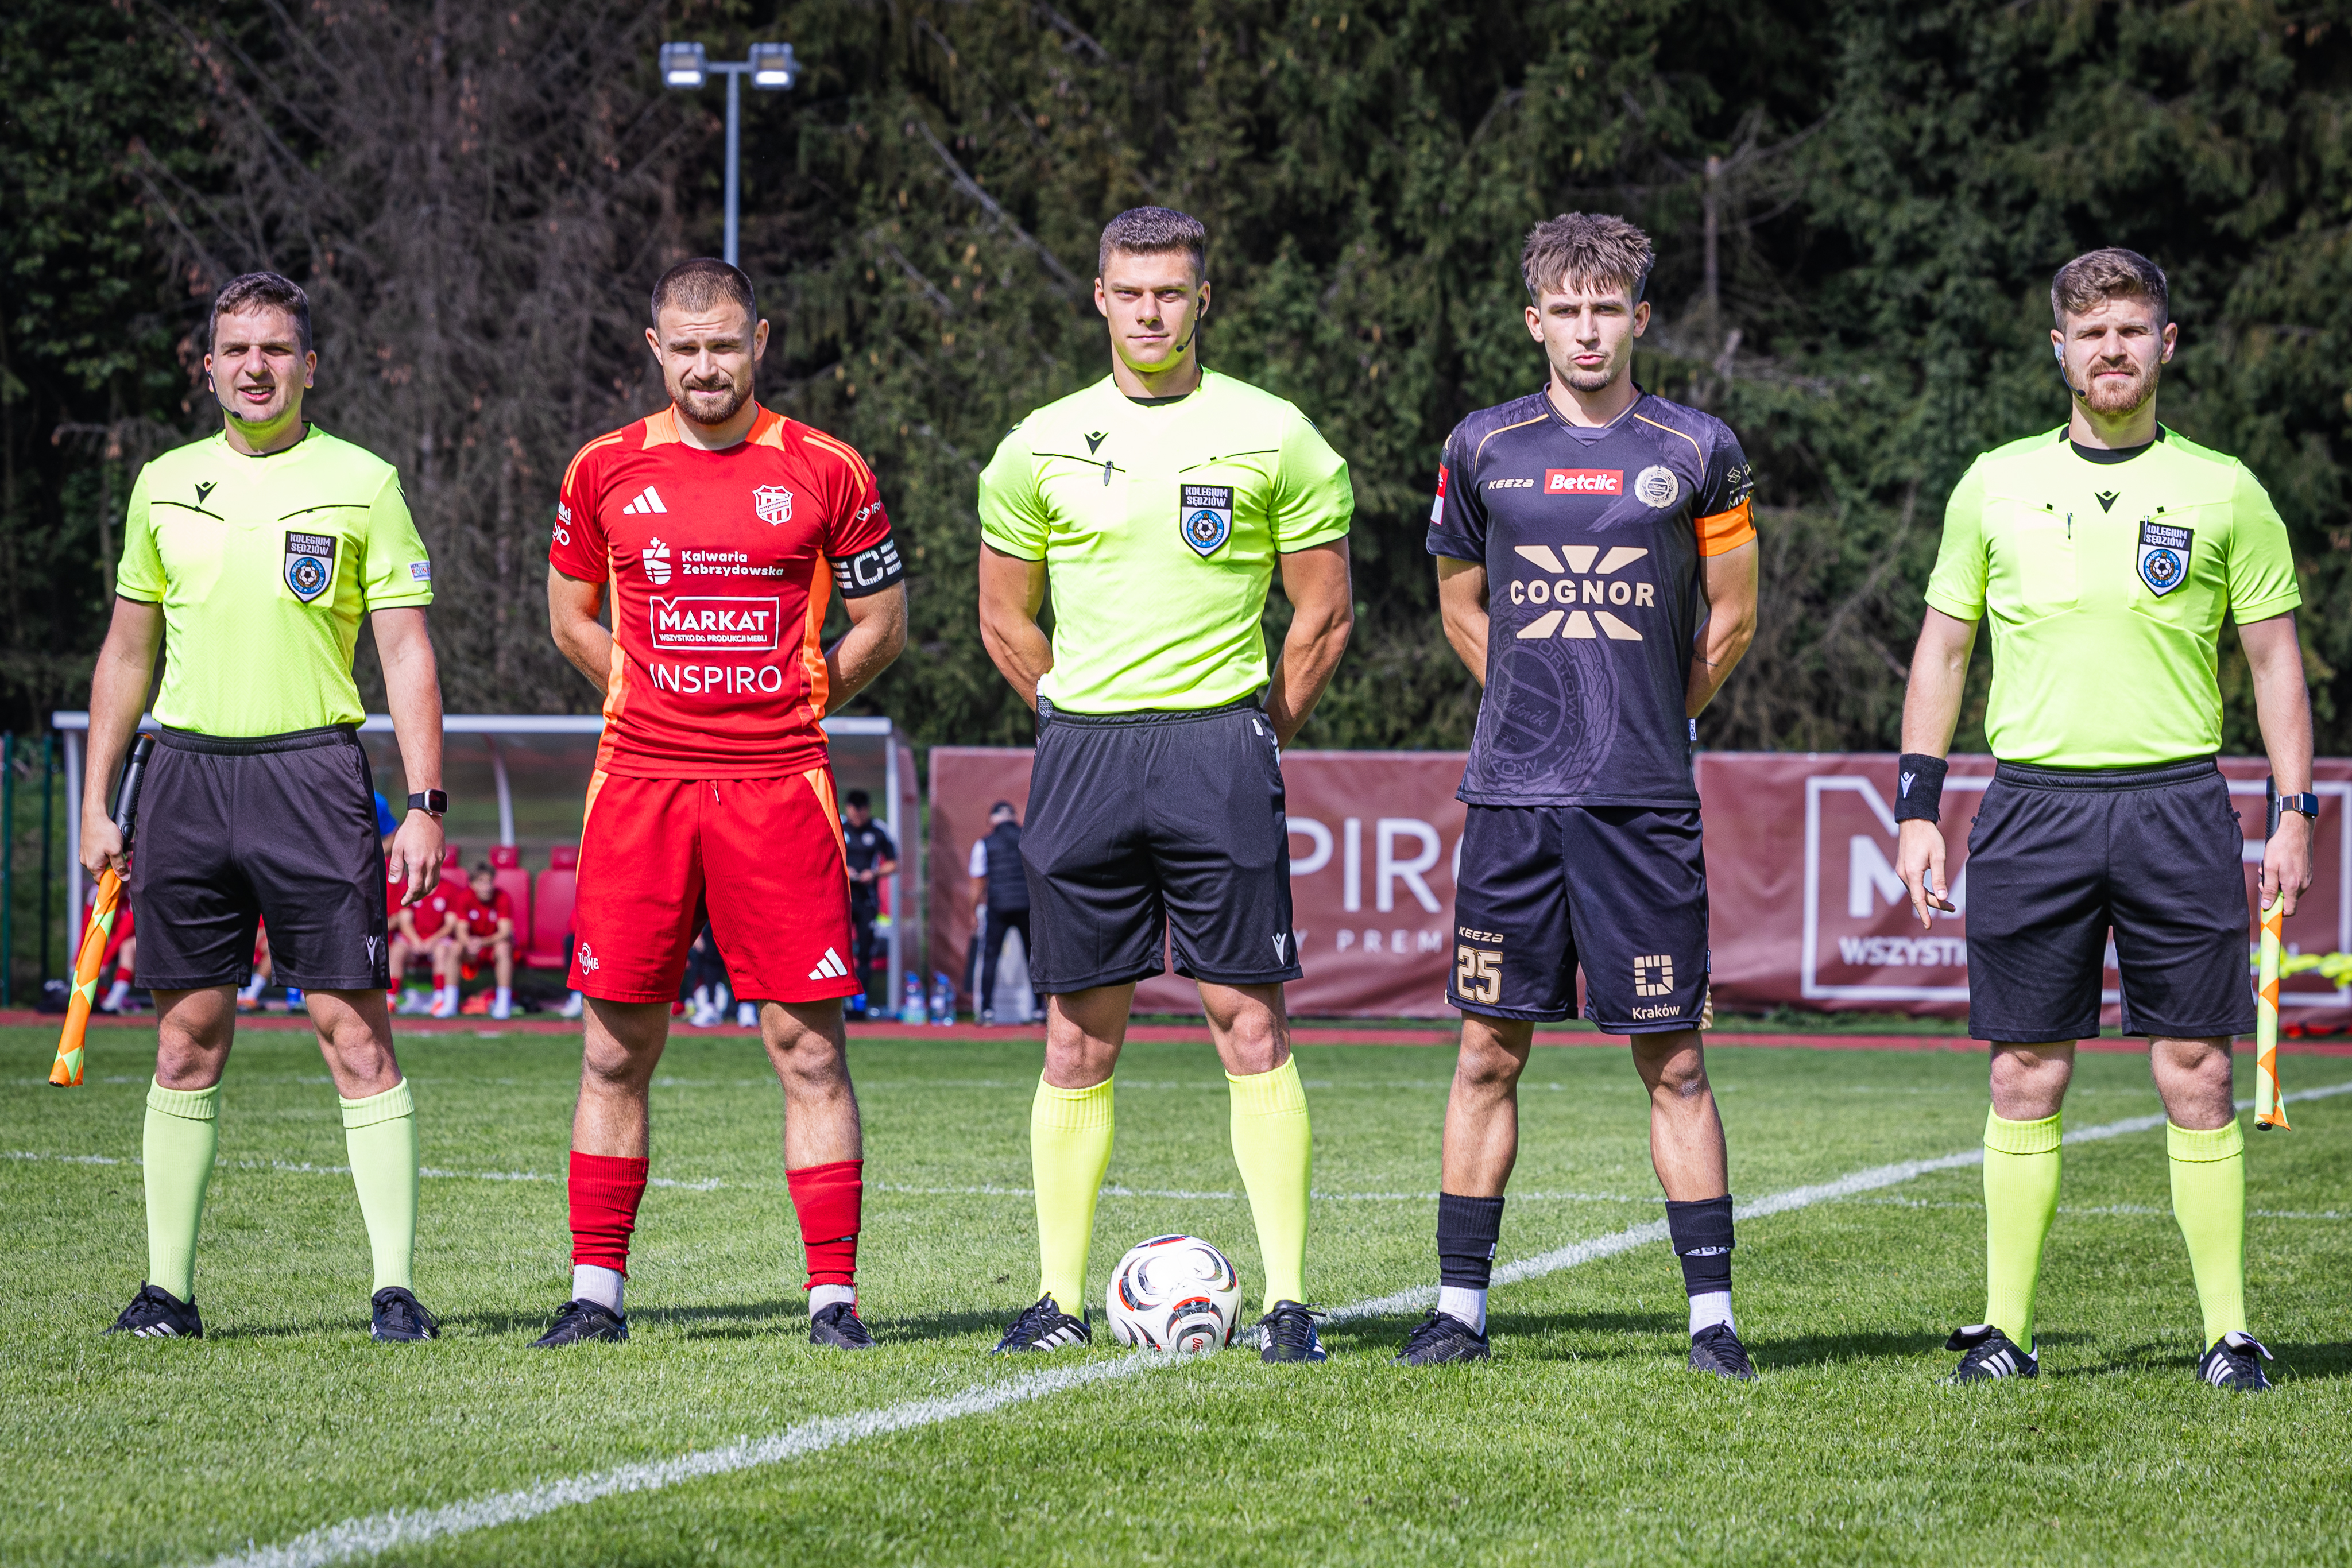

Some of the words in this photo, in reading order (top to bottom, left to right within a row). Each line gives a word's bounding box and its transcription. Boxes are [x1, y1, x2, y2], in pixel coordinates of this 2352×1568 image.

[1550, 473, 1618, 491] Betclic
[1185, 486, 1228, 498] KOLEGIUM
[1186, 495, 1226, 507] SĘDZIÓW
[290, 533, 331, 547] KOLEGIUM
[2145, 533, 2185, 548] SĘDZIÓW
[291, 543, 329, 555] SĘDZIÓW
[682, 550, 748, 562] Kalwaria
[682, 563, 784, 577] Zebrzydowska
[1510, 579, 1655, 607] COGNOR
[659, 610, 769, 631] MARKAT
[659, 634, 695, 642] WSZYSTKO
[707, 634, 746, 642] PRODUKCJI
[649, 663, 782, 693] INSPIRO
[1457, 944, 1503, 1005] 25
[1632, 1002, 1680, 1019] Kraków
